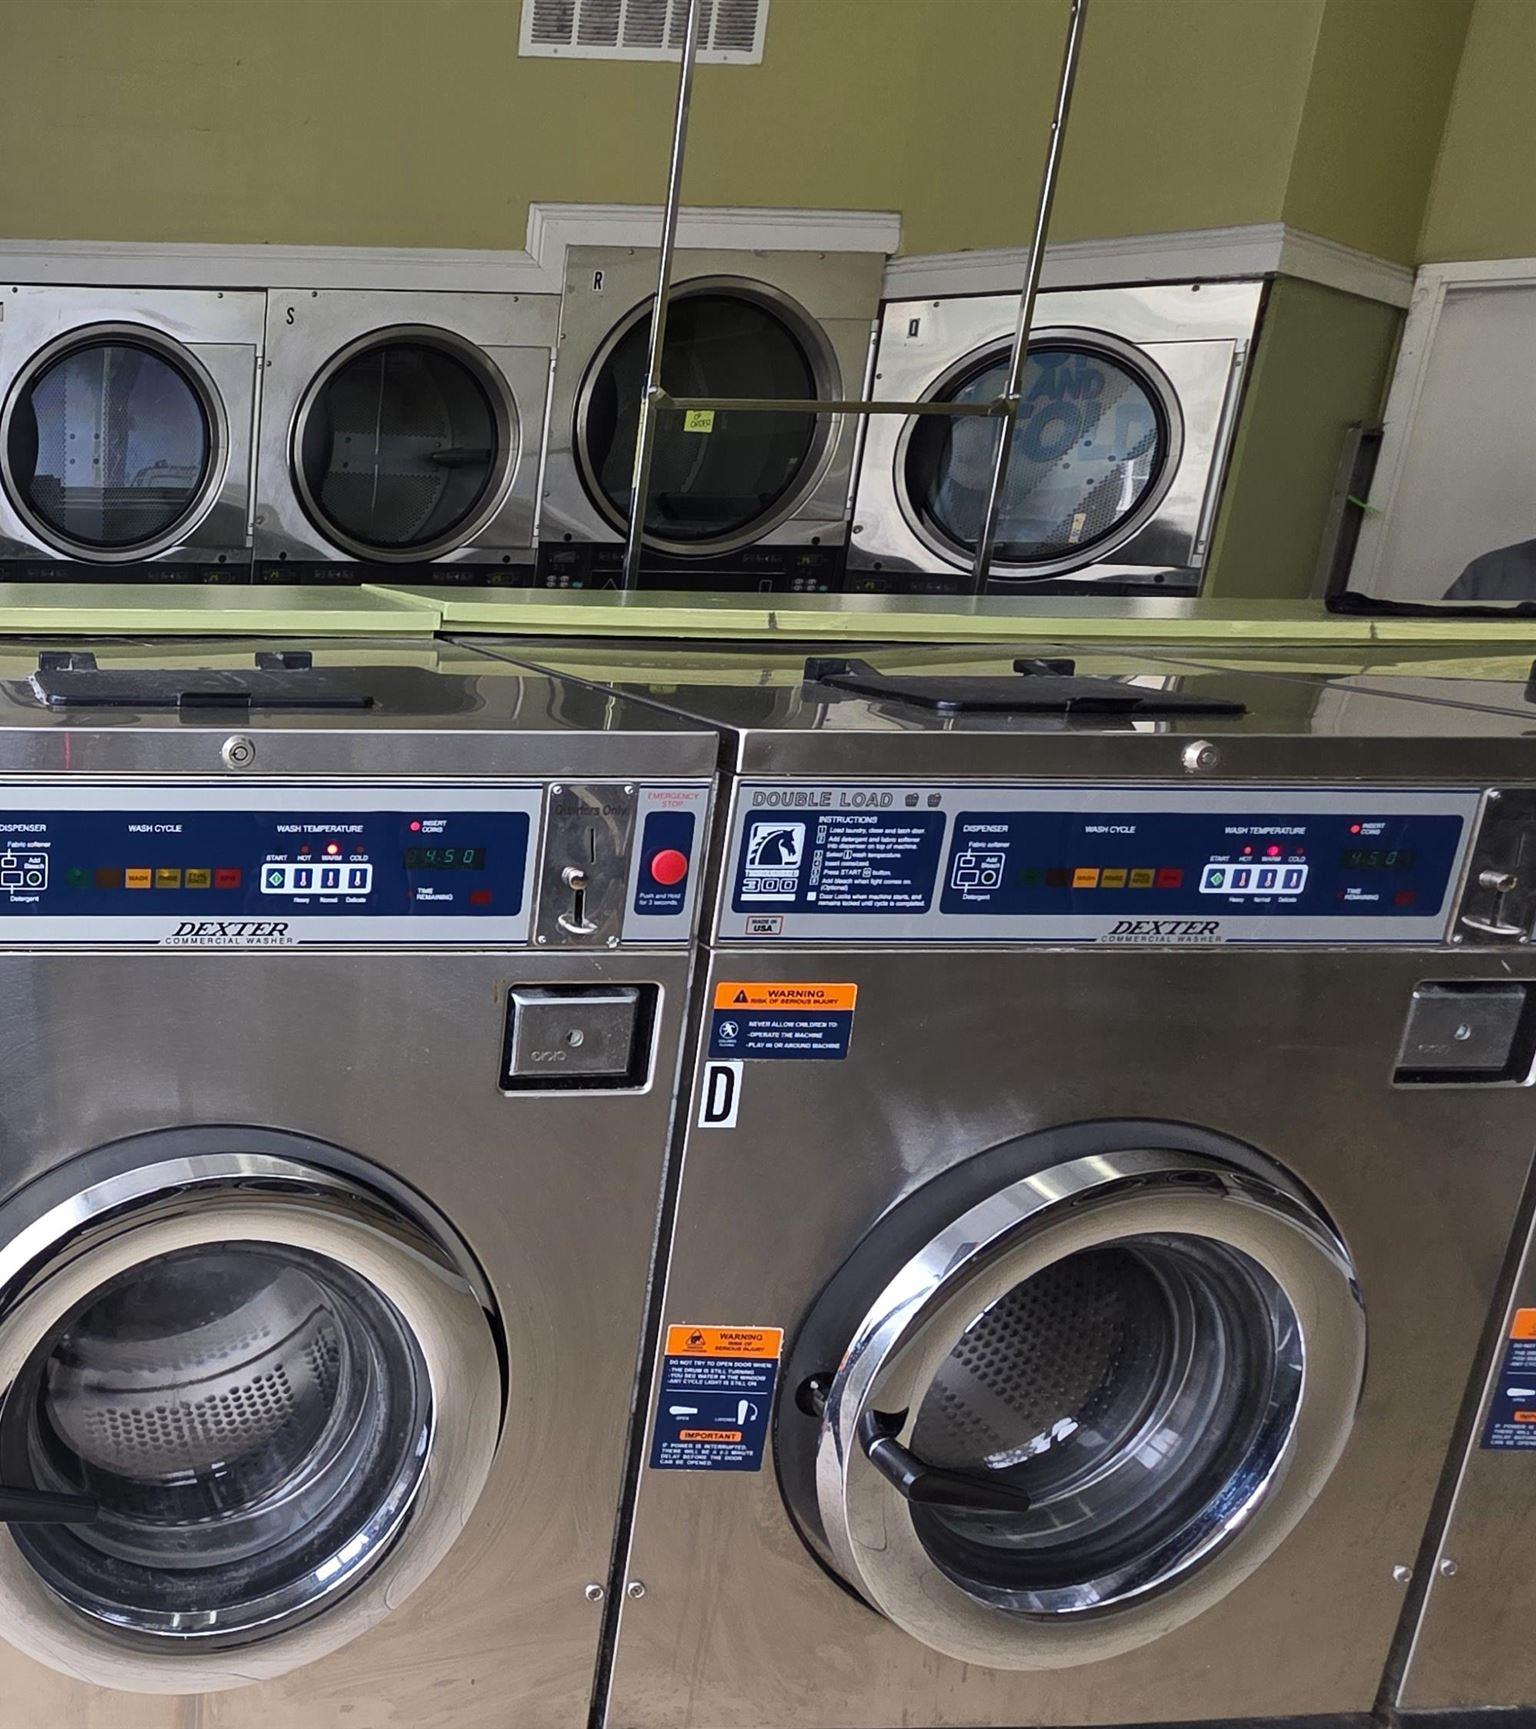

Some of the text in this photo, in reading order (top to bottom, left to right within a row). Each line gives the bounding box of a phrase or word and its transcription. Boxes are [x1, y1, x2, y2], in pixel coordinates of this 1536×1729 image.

[593, 272, 603, 290] R
[286, 307, 294, 325] S
[752, 792, 894, 807] DOUBLE LOAD
[603, 804, 628, 817] Only
[304, 825, 363, 833] TEMPERATURE
[742, 878, 797, 892] 300
[172, 922, 289, 936] DEXTER
[1109, 921, 1220, 935] DEXTER
[768, 990, 824, 998] WARNING
[704, 1066, 735, 1122] D
[720, 1333, 763, 1341] WARNING
